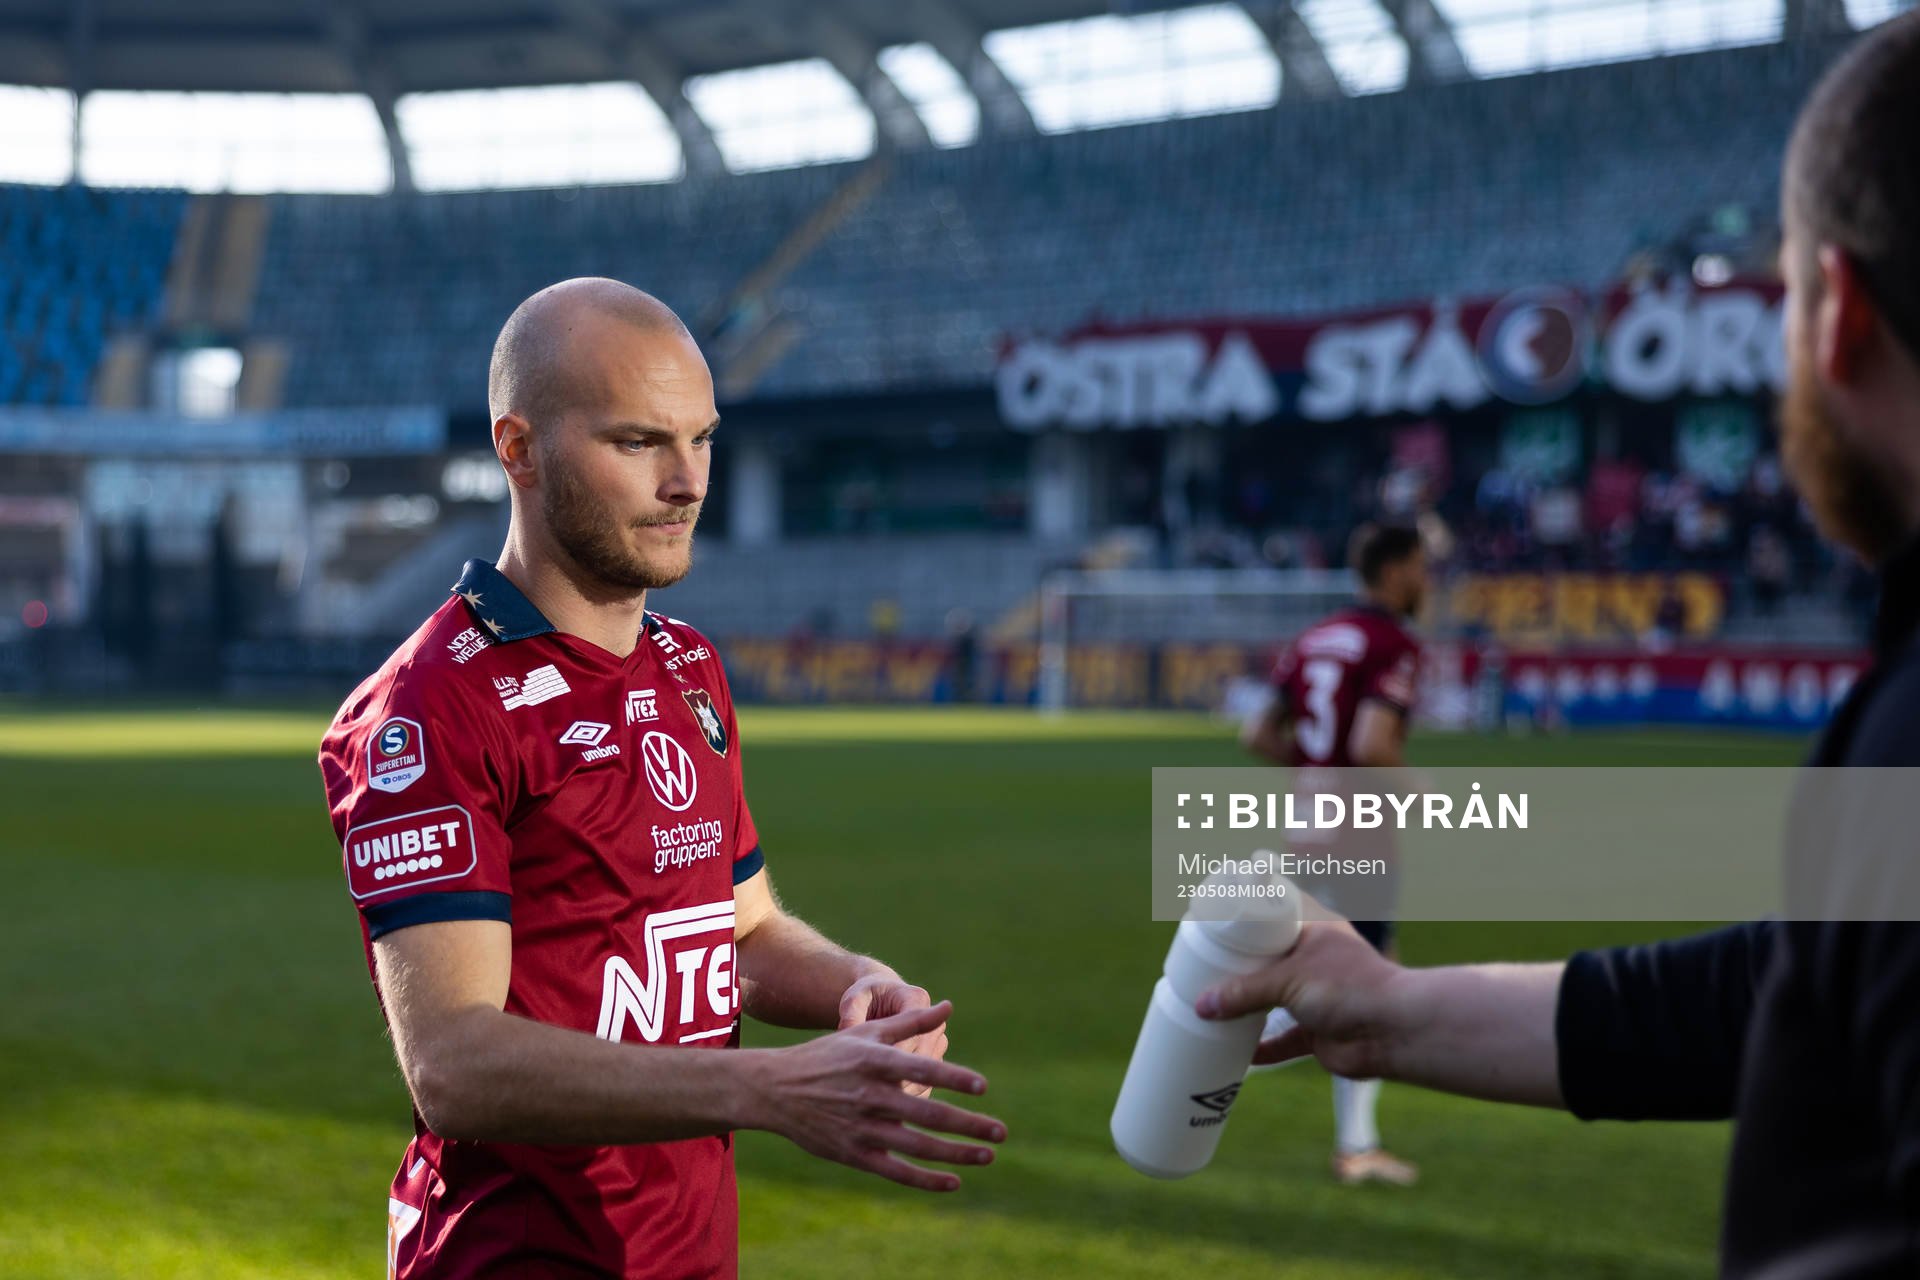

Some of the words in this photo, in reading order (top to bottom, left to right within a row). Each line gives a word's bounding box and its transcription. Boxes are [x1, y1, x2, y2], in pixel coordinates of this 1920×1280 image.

[625, 689, 660, 726] NTEX
[1297, 659, 1343, 762] 3
[375, 754, 416, 773] SUPERETTAN
[582, 744, 621, 762] umbro
[354, 821, 460, 867] UNIBET
[651, 817, 722, 849] factoring
[654, 840, 721, 873] gruppen.
[596, 900, 740, 1043] NTE
